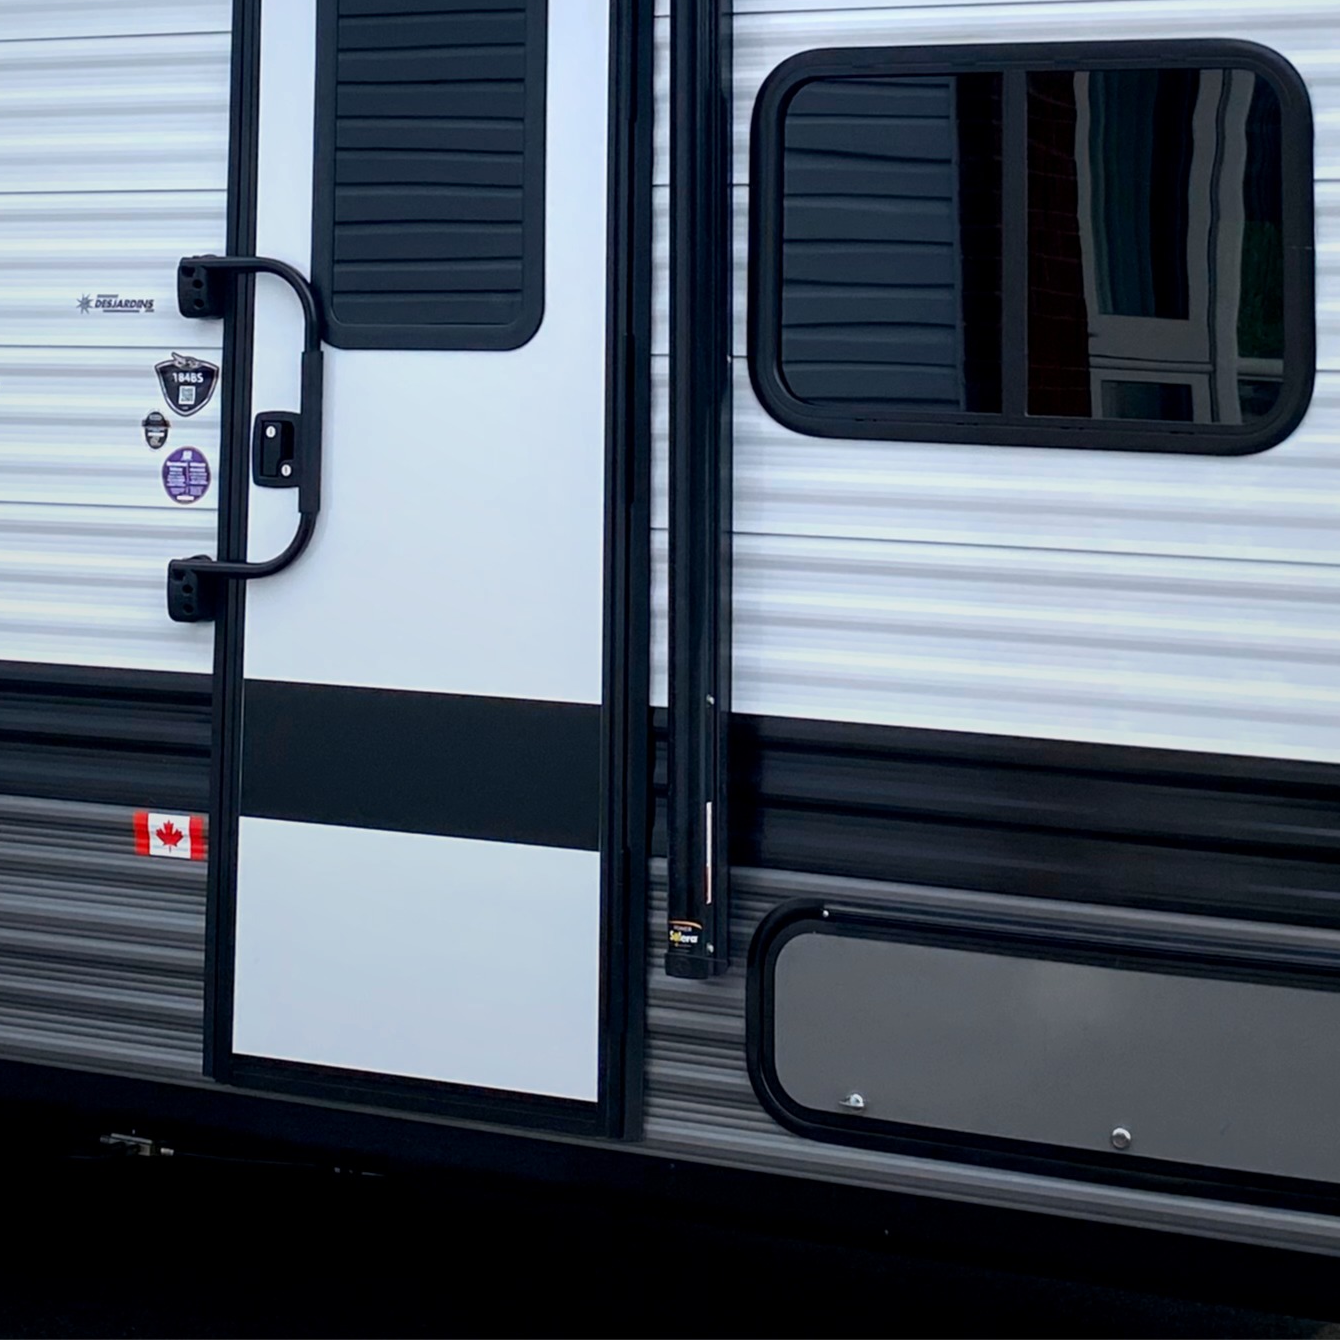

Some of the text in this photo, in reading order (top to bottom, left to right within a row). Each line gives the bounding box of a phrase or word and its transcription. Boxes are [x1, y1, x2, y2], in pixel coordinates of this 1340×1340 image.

[94, 299, 154, 309] DESJARDINS
[172, 372, 204, 383] 184BS
[670, 930, 698, 943] Solera
